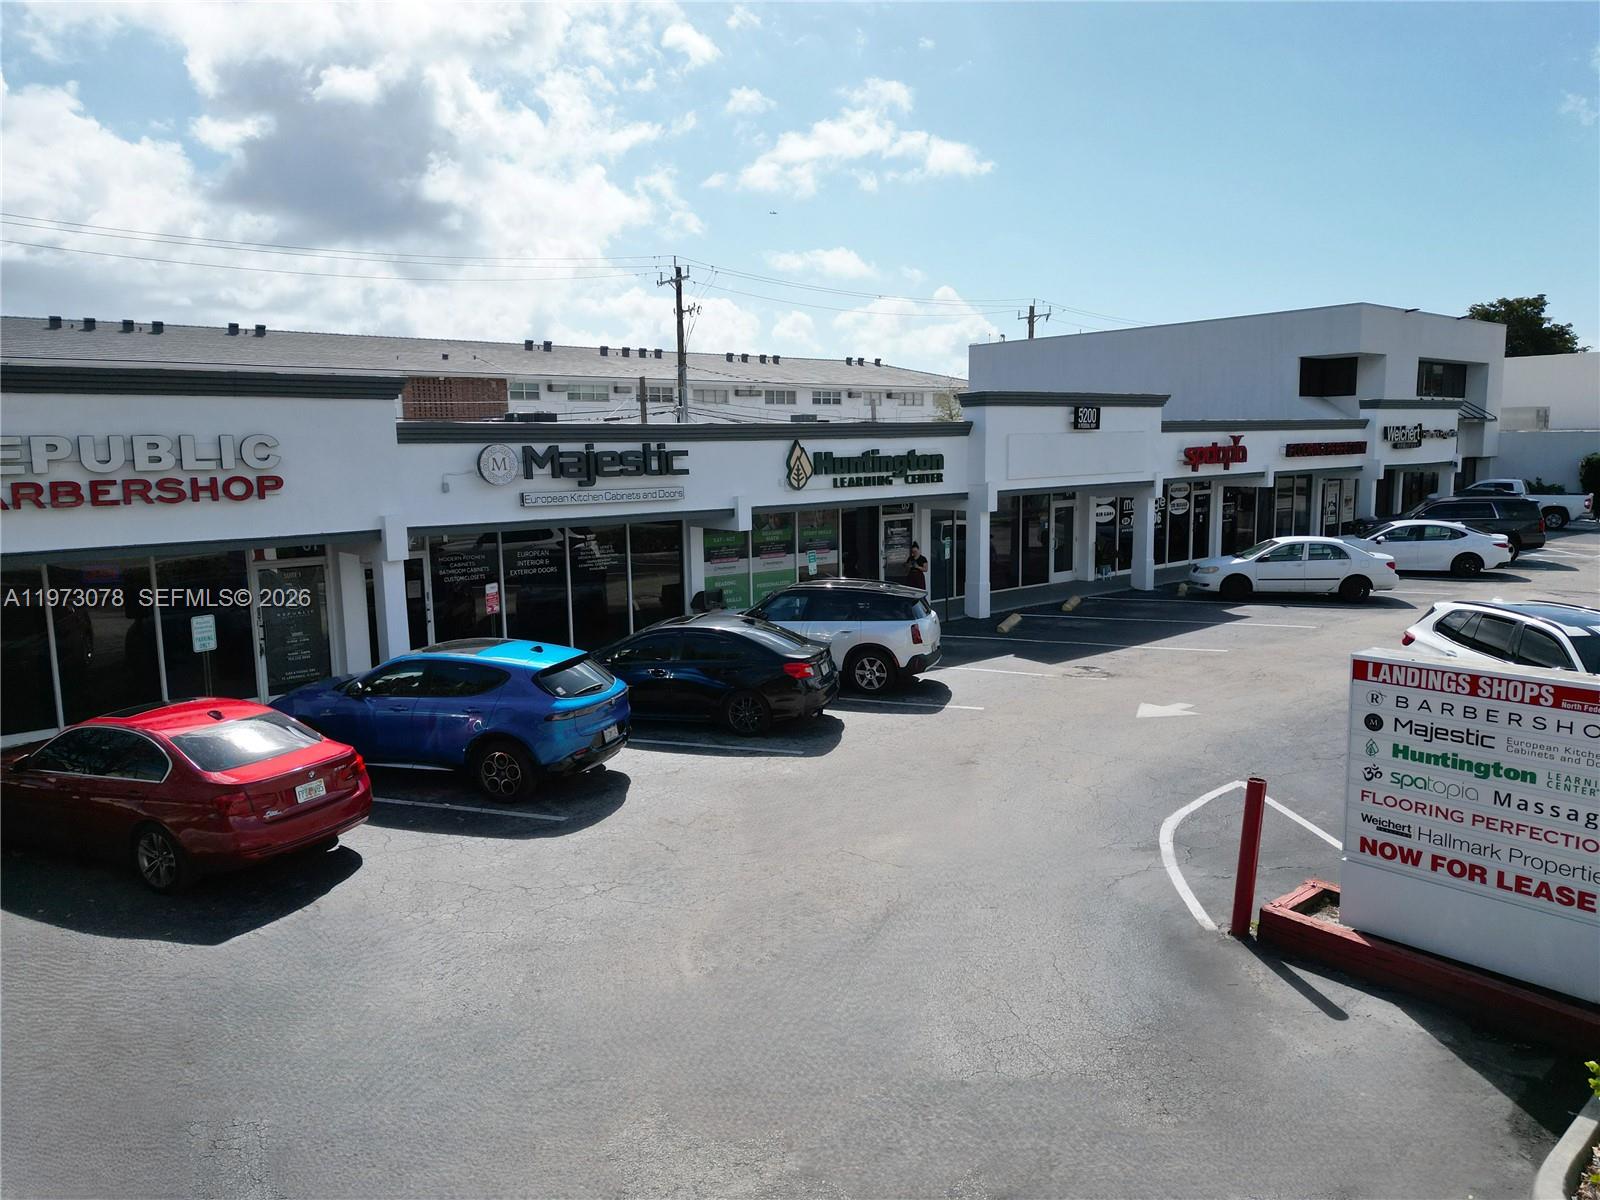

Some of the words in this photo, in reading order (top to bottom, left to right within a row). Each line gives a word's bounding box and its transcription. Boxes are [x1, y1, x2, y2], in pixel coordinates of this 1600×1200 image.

[1079, 407, 1097, 423] 5200
[1384, 423, 1423, 443] Weichert
[491, 459, 509, 476] M
[522, 443, 689, 487] Majestic
[813, 449, 944, 480] Huntington
[833, 475, 893, 489] LEARNING
[905, 472, 944, 487] CENTER
[525, 494, 570, 505] European
[570, 492, 605, 503] Kitchen
[604, 490, 642, 503] Cabinets
[642, 490, 658, 499] and
[657, 487, 686, 499] Doors
[517, 550, 550, 558] EUROPEAN
[510, 569, 537, 577] EXTERIOR
[1367, 662, 1471, 697] LANDINGS
[1477, 679, 1555, 707] SHOPS
[1561, 701, 1582, 711] North
[1394, 717, 1496, 753] Majestic
[1506, 737, 1559, 753] European
[1392, 743, 1537, 784] Huntington
[1506, 747, 1555, 761] Cabinets
[1560, 756, 1581, 769] and
[1390, 772, 1479, 802] spatopia
[1361, 789, 1464, 828] FLOORING
[1361, 812, 1412, 834] Weichert
[1418, 826, 1502, 865] Hallmark
[1359, 836, 1423, 867] NOW
[1431, 854, 1488, 889] FOR
[1496, 871, 1600, 914] LEASE
